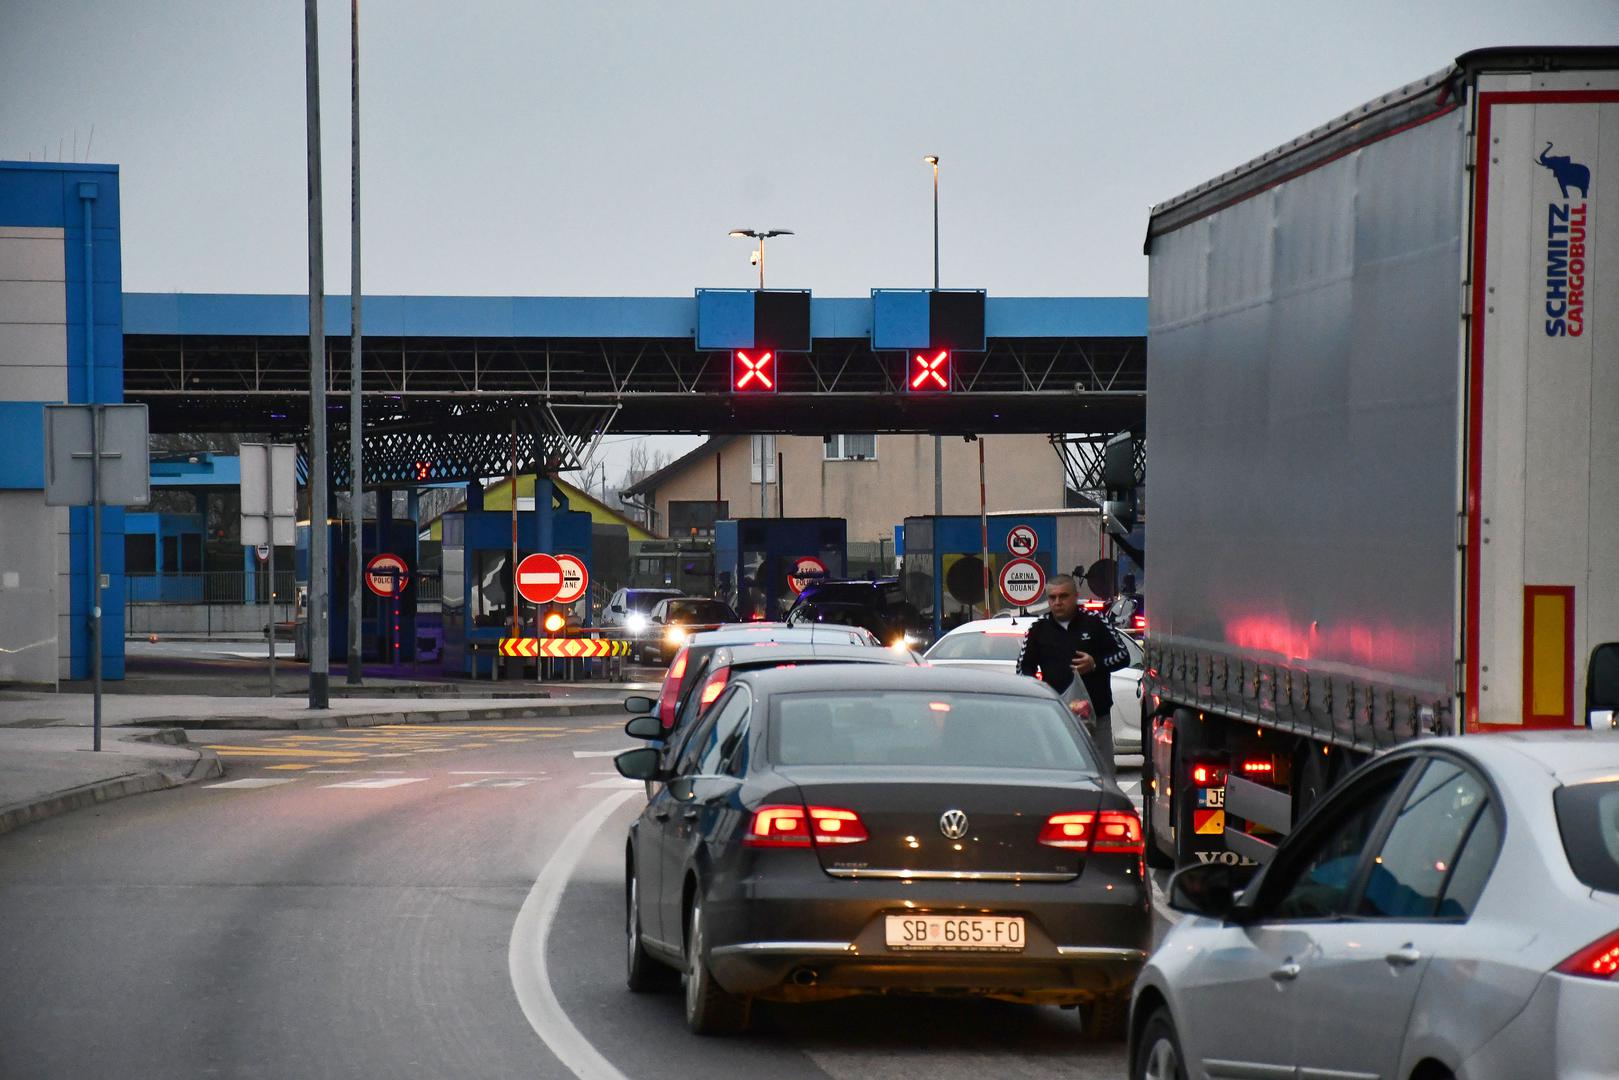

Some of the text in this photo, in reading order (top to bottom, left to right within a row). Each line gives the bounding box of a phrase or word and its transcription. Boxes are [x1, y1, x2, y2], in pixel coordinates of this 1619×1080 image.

[1545, 203, 1569, 337] SCHMITZ
[1567, 203, 1588, 337] CARGOBULL
[1010, 572, 1035, 580] CARINA
[1009, 584, 1036, 592] DOUANE
[1194, 851, 1259, 866] VOL
[903, 919, 928, 942] SB
